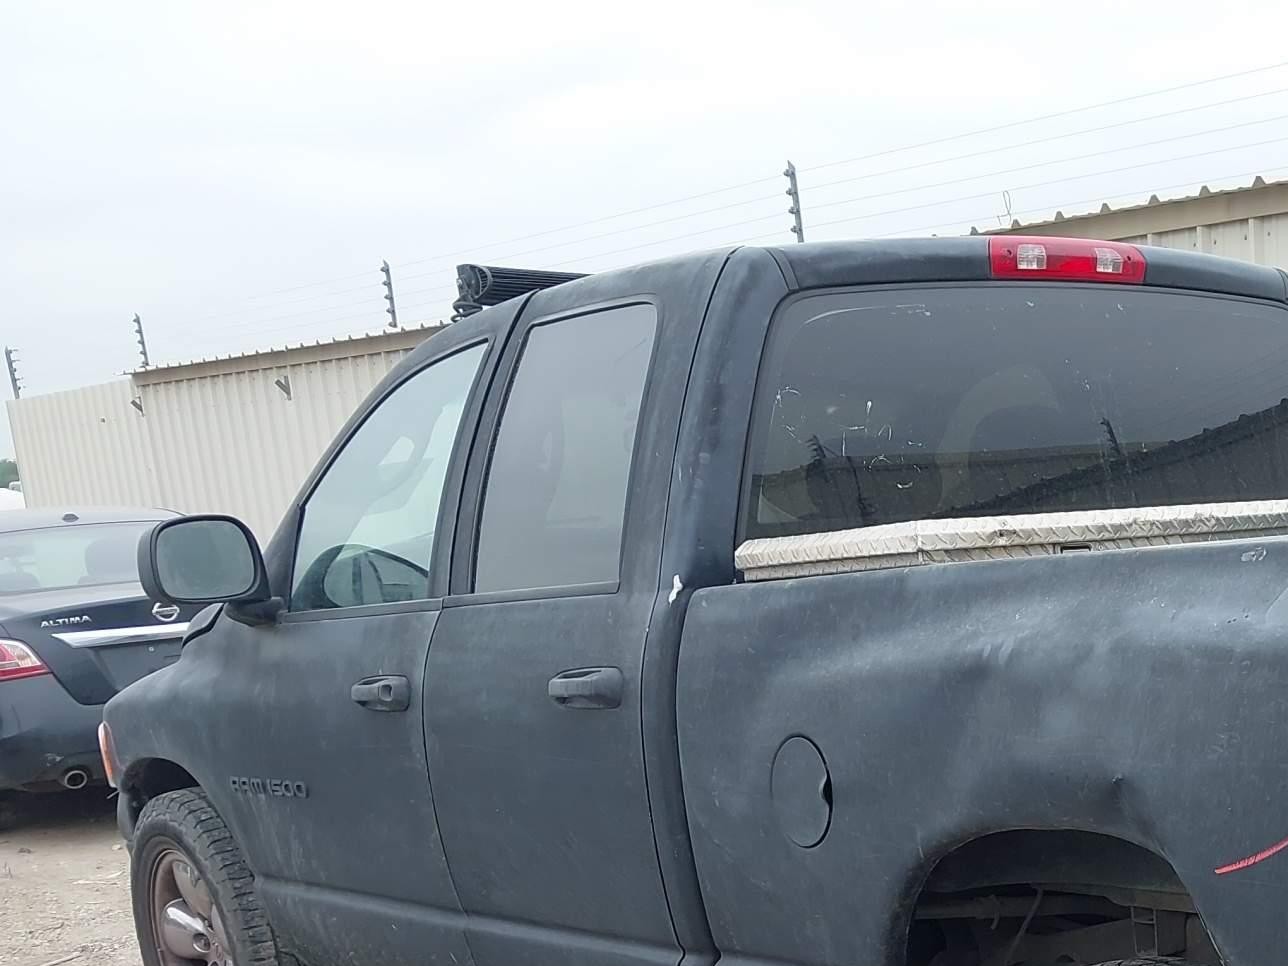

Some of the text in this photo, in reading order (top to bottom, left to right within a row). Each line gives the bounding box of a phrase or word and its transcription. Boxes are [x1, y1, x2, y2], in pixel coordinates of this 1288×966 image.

[40, 615, 92, 629] ALTIMA
[230, 776, 308, 798] RAM 1500
